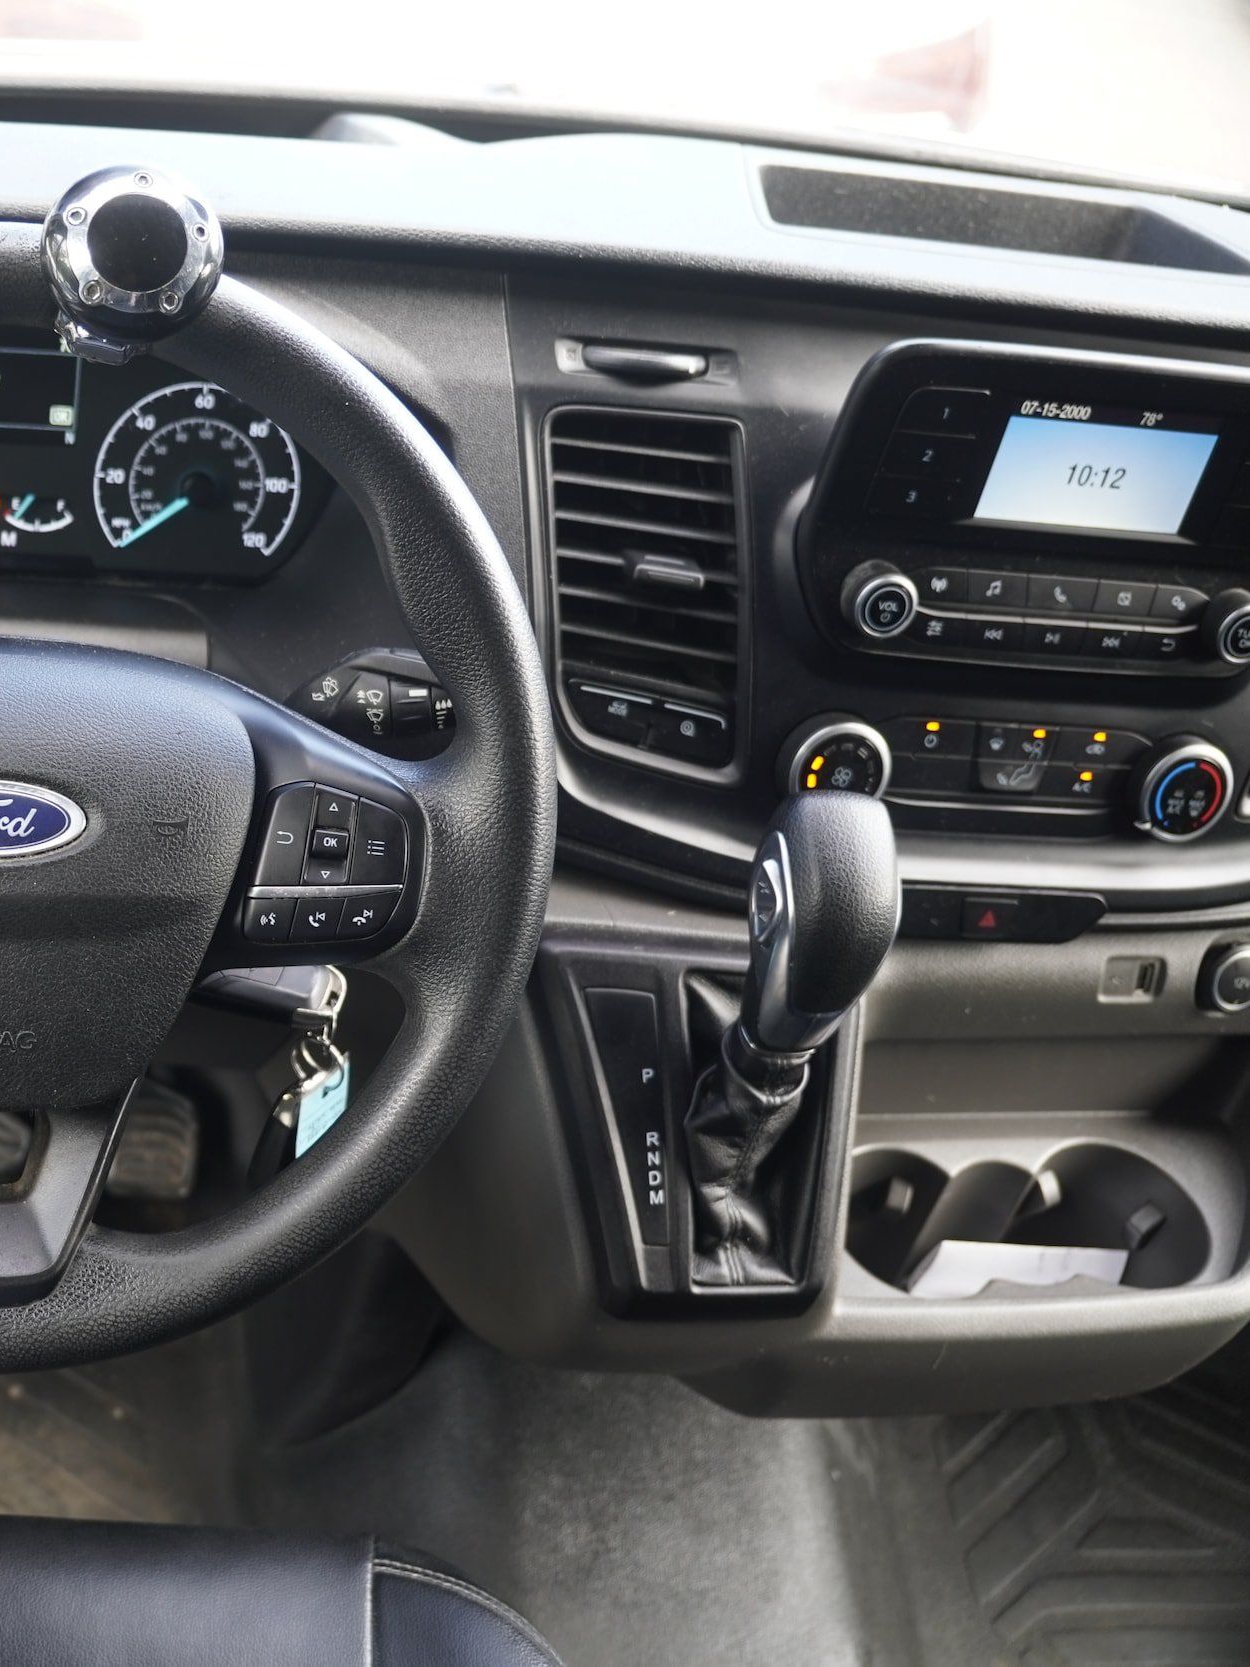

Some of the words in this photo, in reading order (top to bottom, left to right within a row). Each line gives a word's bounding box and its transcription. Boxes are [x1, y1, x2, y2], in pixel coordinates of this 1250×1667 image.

[194, 393, 216, 410] 60
[1020, 401, 1092, 421] 07-15-2000
[135, 414, 156, 431] 40
[249, 421, 269, 438] 80
[921, 450, 934, 462] 2
[105, 467, 126, 485] 20
[1064, 463, 1127, 490] 10:12
[264, 477, 290, 494] 100
[906, 490, 917, 503] 3
[57, 499, 65, 513] F
[0, 531, 17, 547] M
[243, 532, 267, 549] 120
[878, 601, 898, 612] VOL
[323, 837, 338, 848] OK
[641, 1068, 654, 1083] P
[646, 1131, 660, 1147] R
[647, 1151, 660, 1166] N
[648, 1170, 661, 1186] D
[649, 1190, 664, 1205] M
